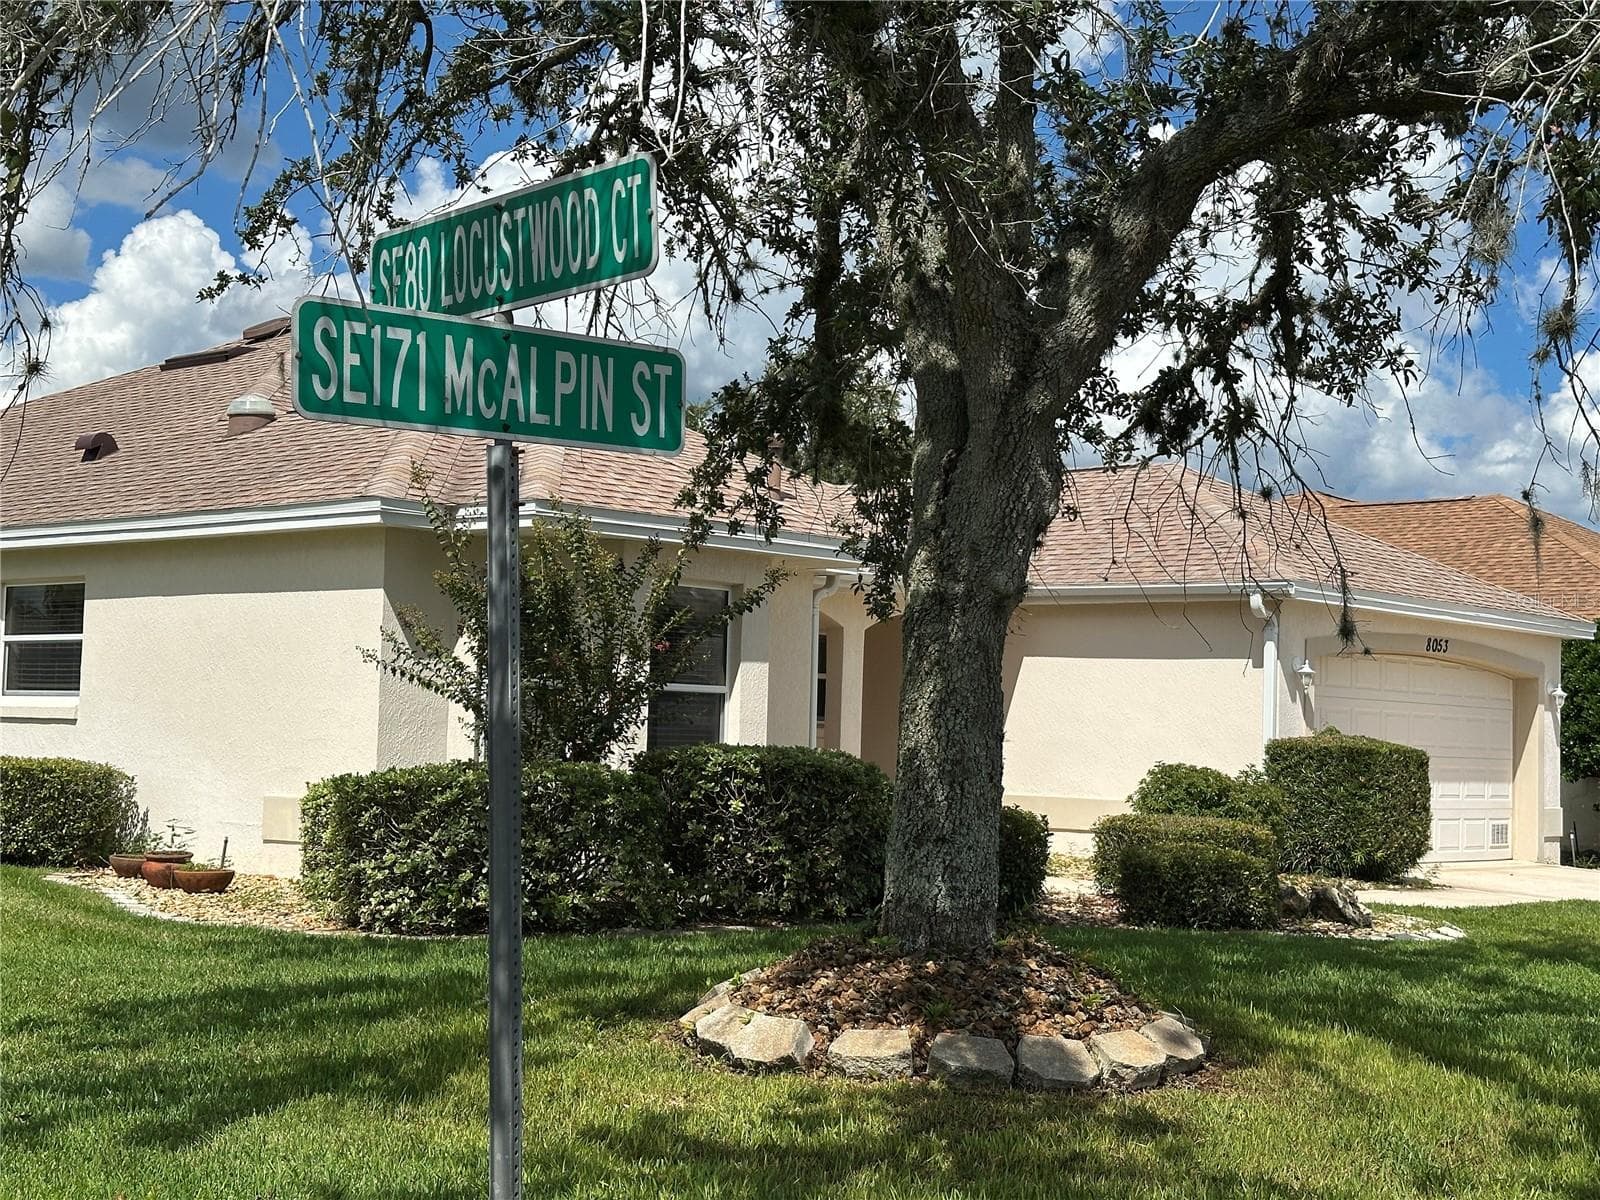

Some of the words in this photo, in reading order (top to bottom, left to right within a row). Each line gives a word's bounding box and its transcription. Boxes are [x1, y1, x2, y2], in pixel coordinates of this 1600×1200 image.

[440, 187, 600, 307] LOCUSTWOOD
[611, 173, 642, 264] CT
[311, 315, 427, 412] SE171
[630, 360, 673, 439] ST
[1425, 637, 1449, 653] 8053
